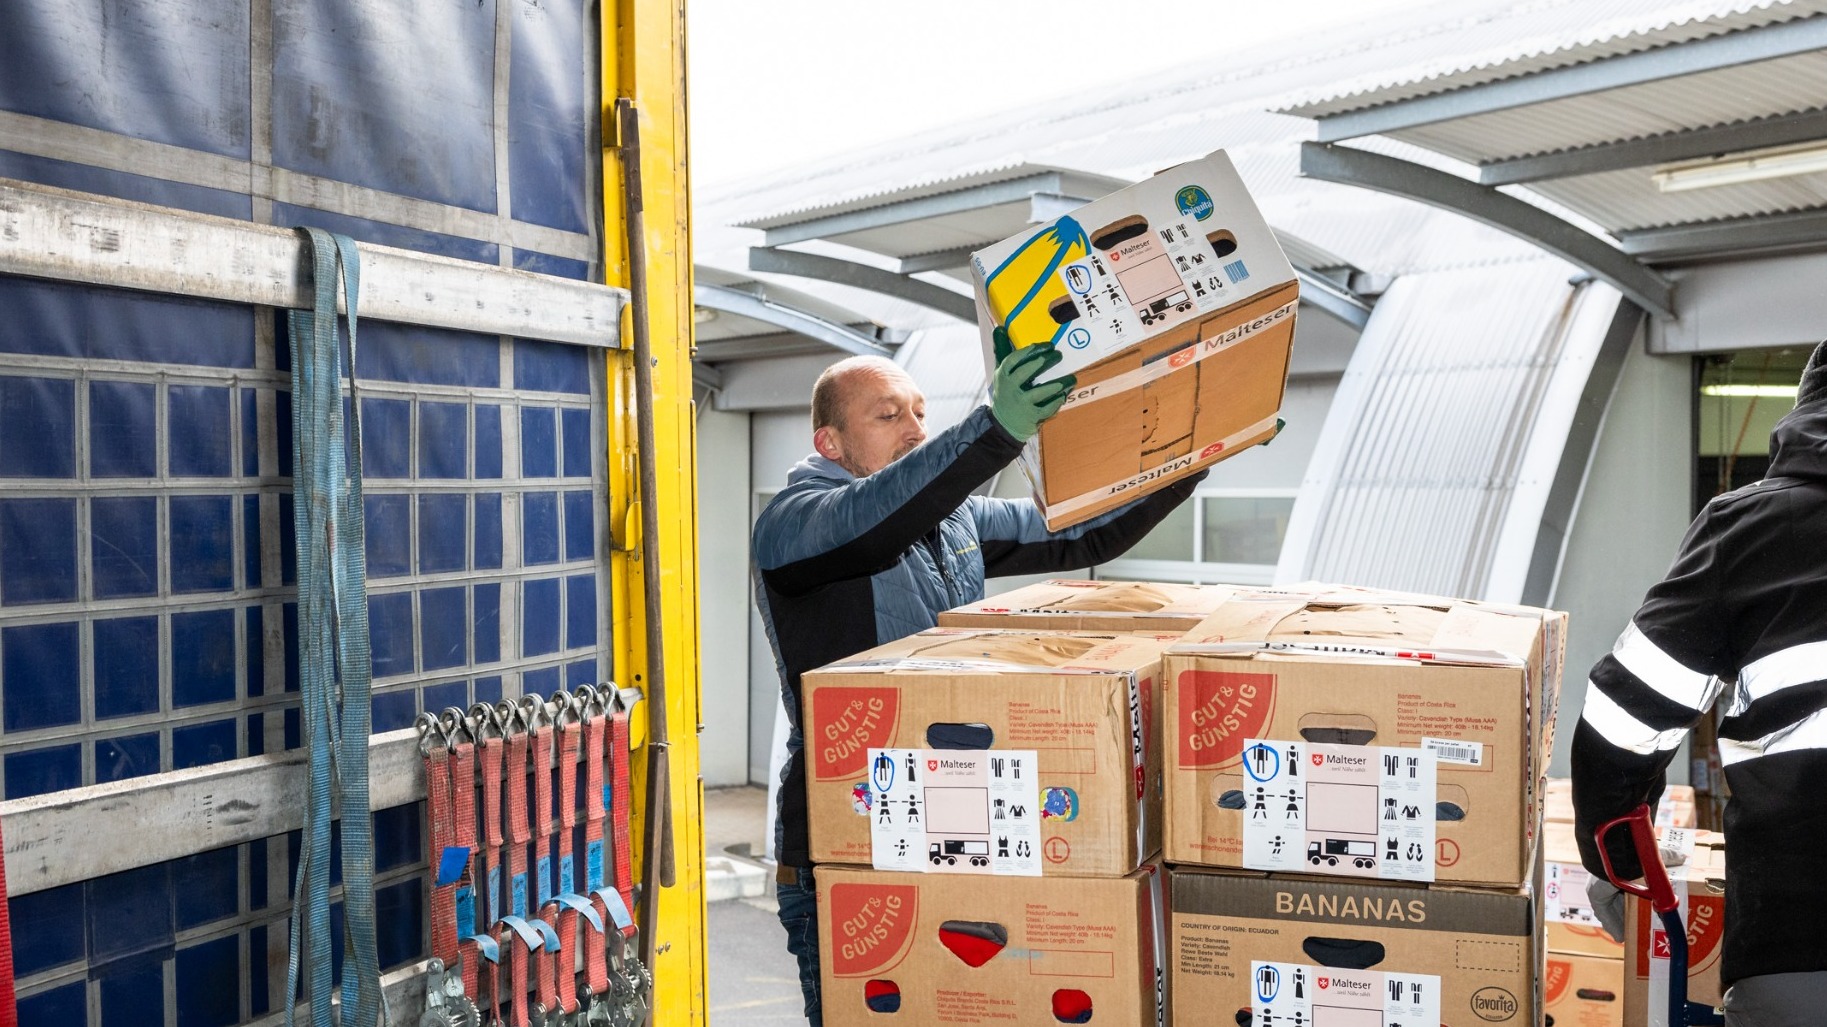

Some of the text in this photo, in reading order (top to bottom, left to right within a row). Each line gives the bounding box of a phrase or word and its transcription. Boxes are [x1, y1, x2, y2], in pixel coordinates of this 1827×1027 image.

[1182, 201, 1212, 216] Chiquita
[1120, 240, 1150, 256] Malteser
[1204, 304, 1292, 351] Malteser
[1108, 457, 1192, 494] Malteser
[825, 700, 864, 740] GUT &
[1189, 684, 1257, 751] GÜNSTIG
[1192, 686, 1234, 727] GUT &
[824, 698, 884, 763] GÜNSTIG
[940, 760, 976, 768] Malteser
[1327, 754, 1366, 764] Malteser
[843, 897, 881, 937] GUT &
[1276, 892, 1426, 923] BANANAS
[842, 895, 901, 960] GÜNSTIG
[1332, 978, 1372, 989] Malteser
[1475, 995, 1514, 1013] favorita
